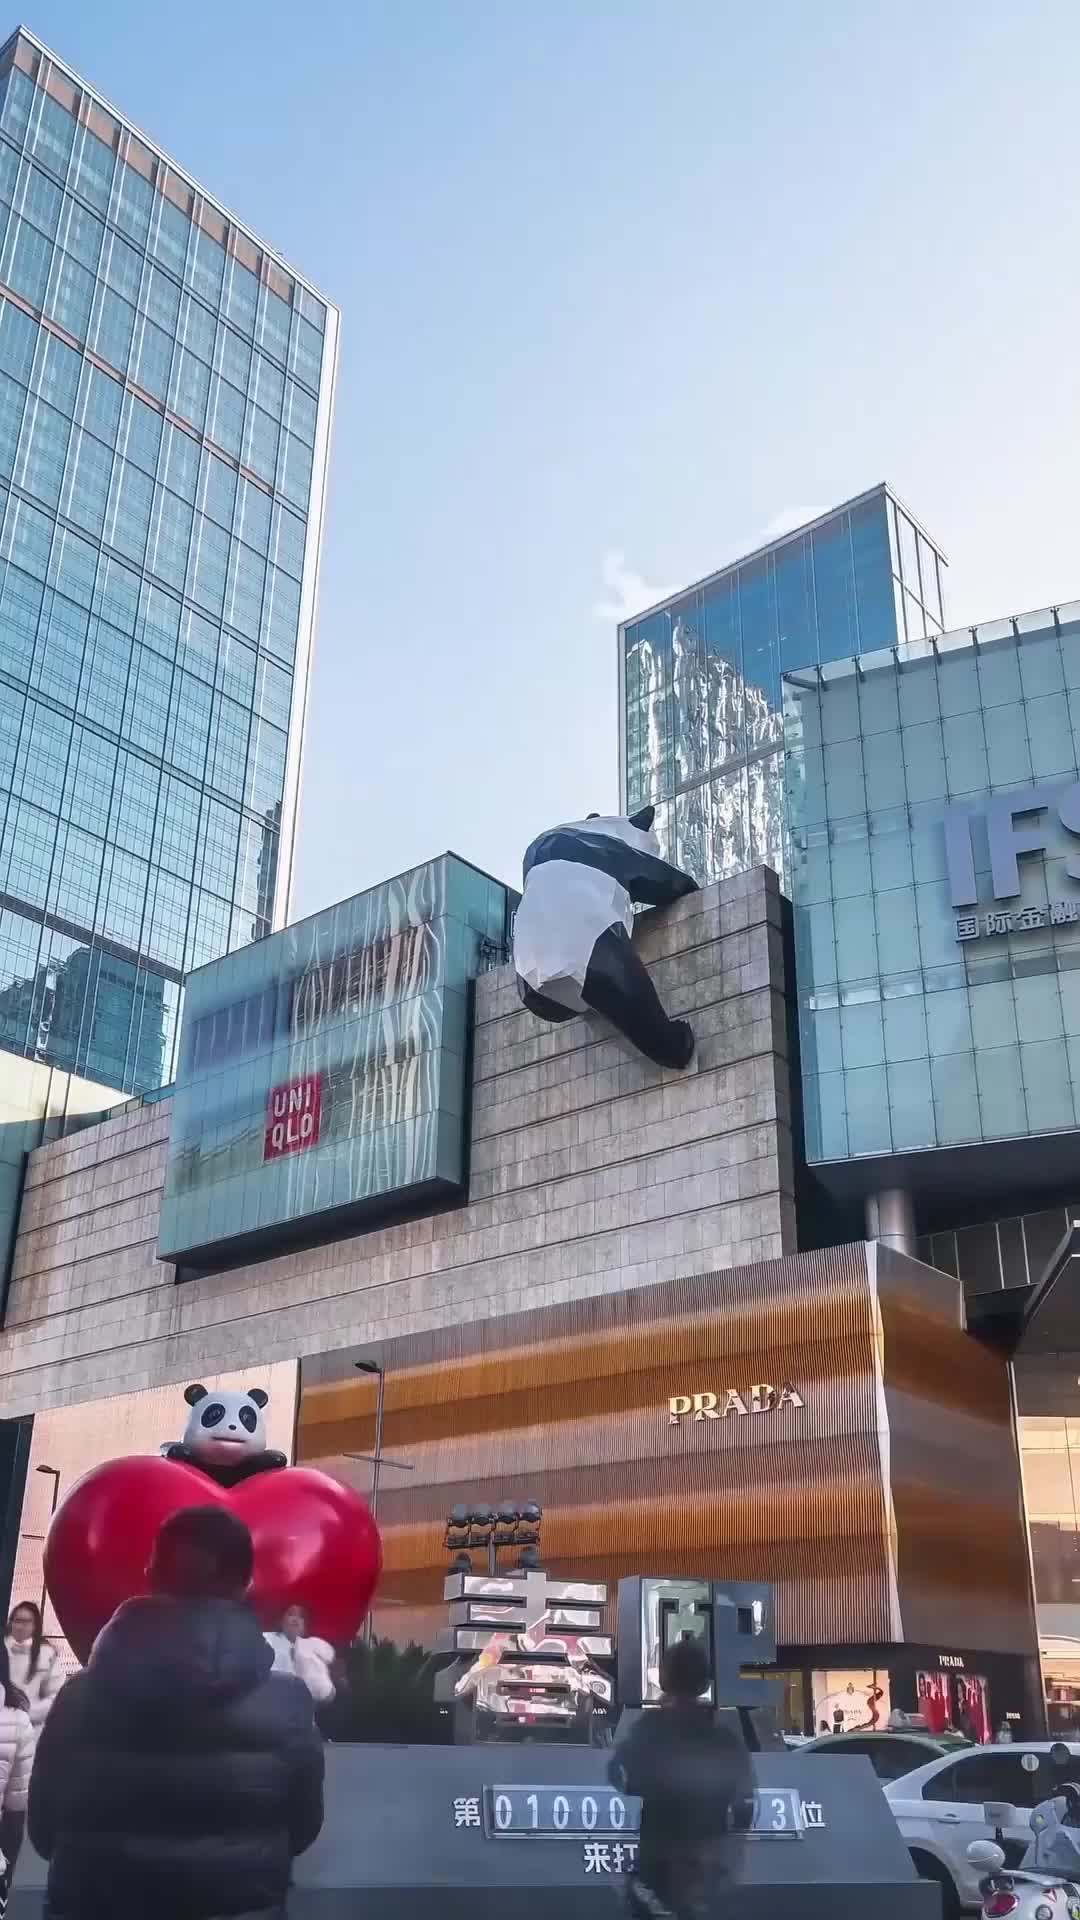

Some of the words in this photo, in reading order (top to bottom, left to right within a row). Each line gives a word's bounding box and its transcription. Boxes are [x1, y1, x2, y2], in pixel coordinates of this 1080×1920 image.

[274, 1083, 311, 1117] UNI
[271, 1113, 312, 1150] QLO
[668, 1380, 804, 1425] PRADA
[939, 1655, 965, 1668] PRADA
[453, 1798, 481, 1828] 第
[800, 1801, 826, 1829] 位
